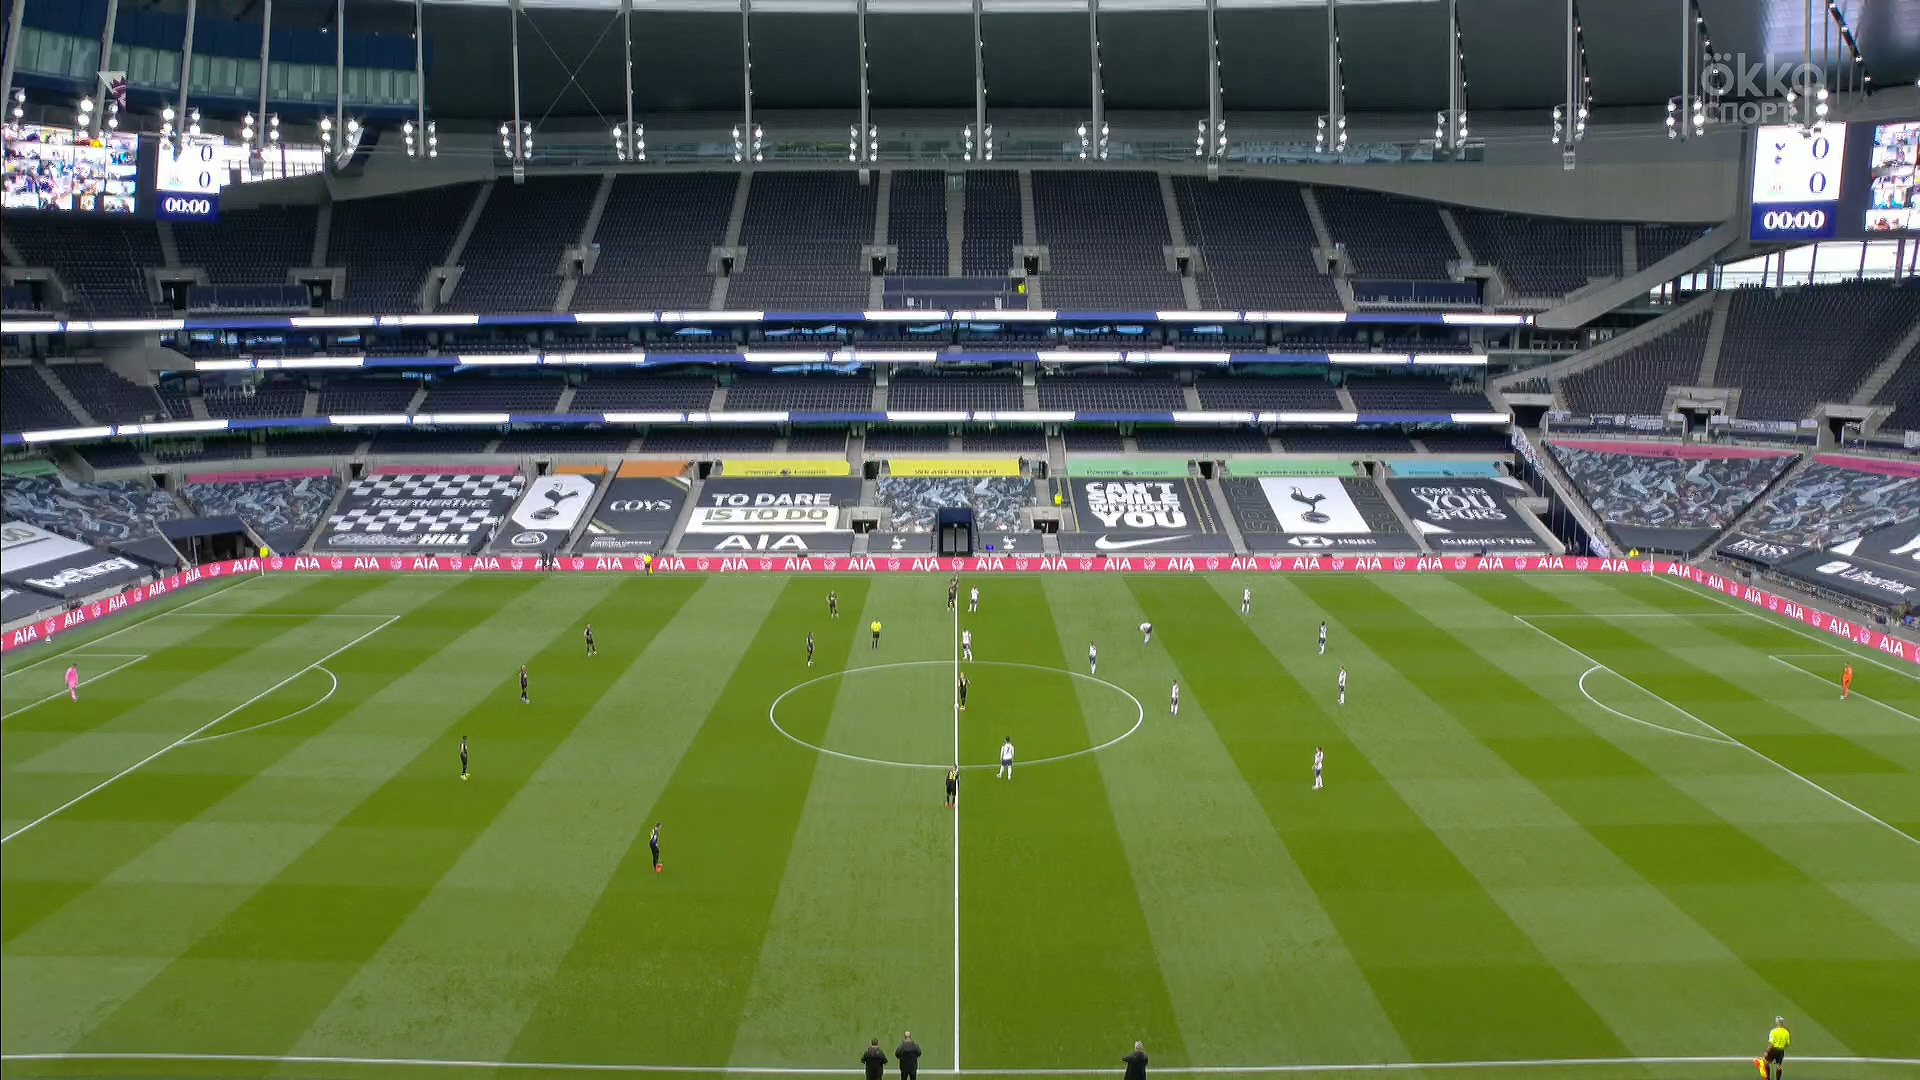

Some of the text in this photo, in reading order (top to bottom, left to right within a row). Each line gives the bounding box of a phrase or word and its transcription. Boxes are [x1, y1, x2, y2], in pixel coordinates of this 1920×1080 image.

[201, 144, 213, 161] 0
[1812, 137, 1829, 160] 0
[199, 170, 211, 188] 0
[1809, 171, 1826, 193] 0
[165, 197, 211, 214] 00:00
[1763, 210, 1826, 230] 00:00
[610, 499, 673, 511] COYS
[712, 492, 832, 507] TO DARE
[1417, 492, 1497, 511] YOU
[704, 508, 828, 521] IS TO DO
[1091, 511, 1187, 528] YOU
[713, 534, 809, 551] AIA
[295, 557, 320, 569] AIA
[354, 556, 379, 569] AIA
[414, 556, 438, 569] AIA
[474, 556, 499, 569] AIA
[597, 556, 622, 569] AIA
[659, 556, 685, 570] AIA
[721, 556, 748, 570] AIA
[785, 556, 811, 570] AIA
[848, 556, 875, 570] AIA
[912, 556, 939, 570] AIA
[976, 556, 1004, 570] AIA
[1040, 556, 1067, 570] AIA
[1105, 556, 1131, 570] AIA
[1168, 556, 1194, 570] AIA
[1230, 556, 1256, 570] AIA
[1293, 556, 1319, 570] AIA
[1356, 556, 1381, 570] AIA
[1417, 556, 1442, 569] AIA
[1478, 556, 1503, 569] AIA
[1538, 556, 1563, 569] AIA
[1601, 559, 1630, 572] AIA
[14, 559, 259, 645] AIA AIA AIA AIA AIA AIA
[1667, 563, 1904, 657] AIA AIA AIA AIA AIA AIA
